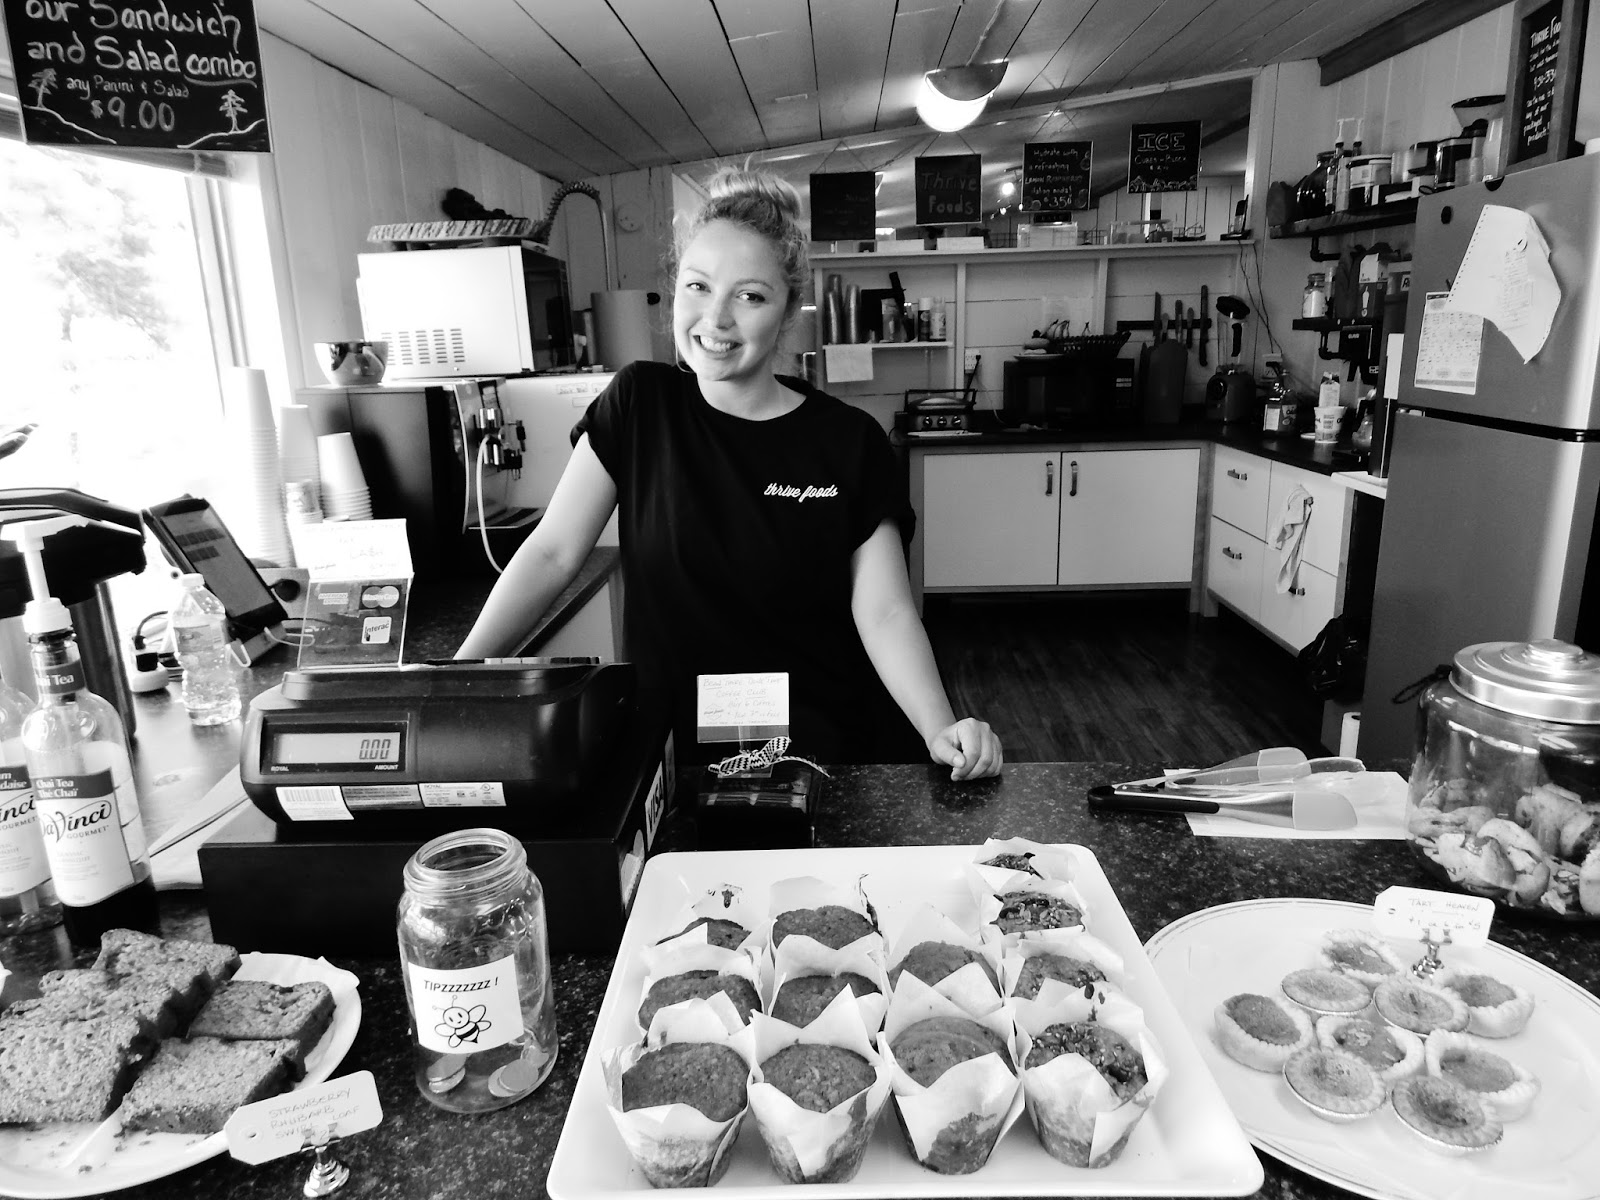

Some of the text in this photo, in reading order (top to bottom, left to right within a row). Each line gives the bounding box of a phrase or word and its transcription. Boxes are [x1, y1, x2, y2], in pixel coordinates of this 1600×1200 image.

[25, 0, 241, 54] our Sandwich
[26, 31, 257, 78] and Salad combo
[66, 77, 91, 99] any
[93, 75, 135, 93] Panini
[153, 80, 189, 98] Salad
[90, 96, 175, 131] $9.00
[1137, 132, 1186, 152] ICE
[921, 171, 977, 191] Thrive
[929, 194, 974, 215] Foods
[763, 482, 839, 503] thrive foods
[51, 675, 75, 686] Tea
[270, 765, 290, 773] ROYAL
[55, 778, 75, 788] Tea
[647, 774, 664, 834] VISA
[0, 816, 37, 832] OURMET
[66, 826, 108, 840] GOURMET
[1445, 902, 1480, 912] HEAVEN
[268, 1087, 351, 1118] STRAWBERRY
[270, 1106, 335, 1129] RHUBARB
[332, 1105, 361, 1121] LOAF
